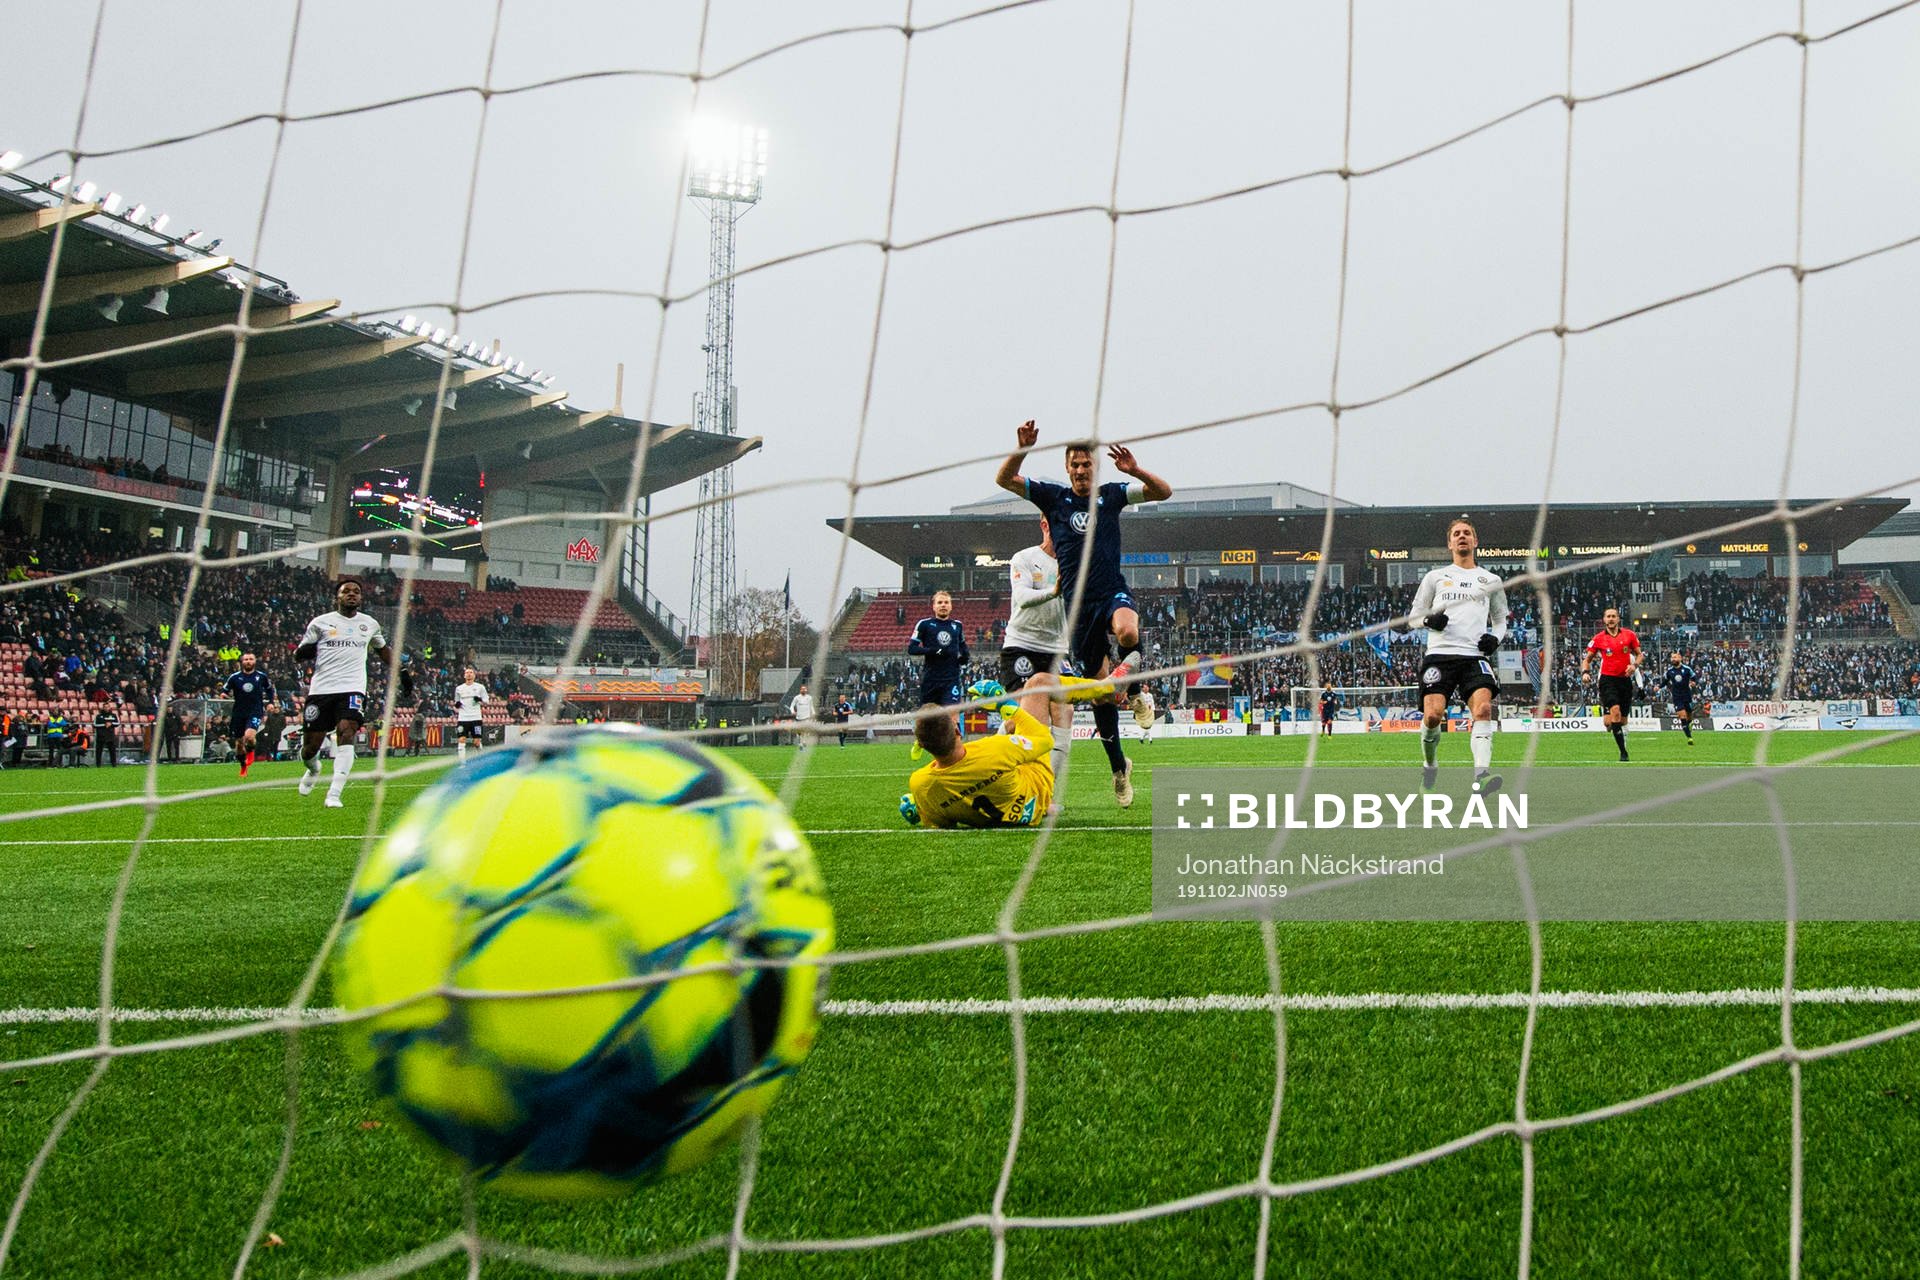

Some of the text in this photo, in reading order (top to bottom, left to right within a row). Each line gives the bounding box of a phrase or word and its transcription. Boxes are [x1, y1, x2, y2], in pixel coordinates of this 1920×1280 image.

[567, 537, 599, 562] MAX
[1721, 544, 1769, 553] MATCHLOGE
[1637, 582, 1659, 593] FULL
[951, 685, 960, 696] 6
[1188, 725, 1233, 736] InnoBo
[1536, 720, 1588, 731] TEKNOS
